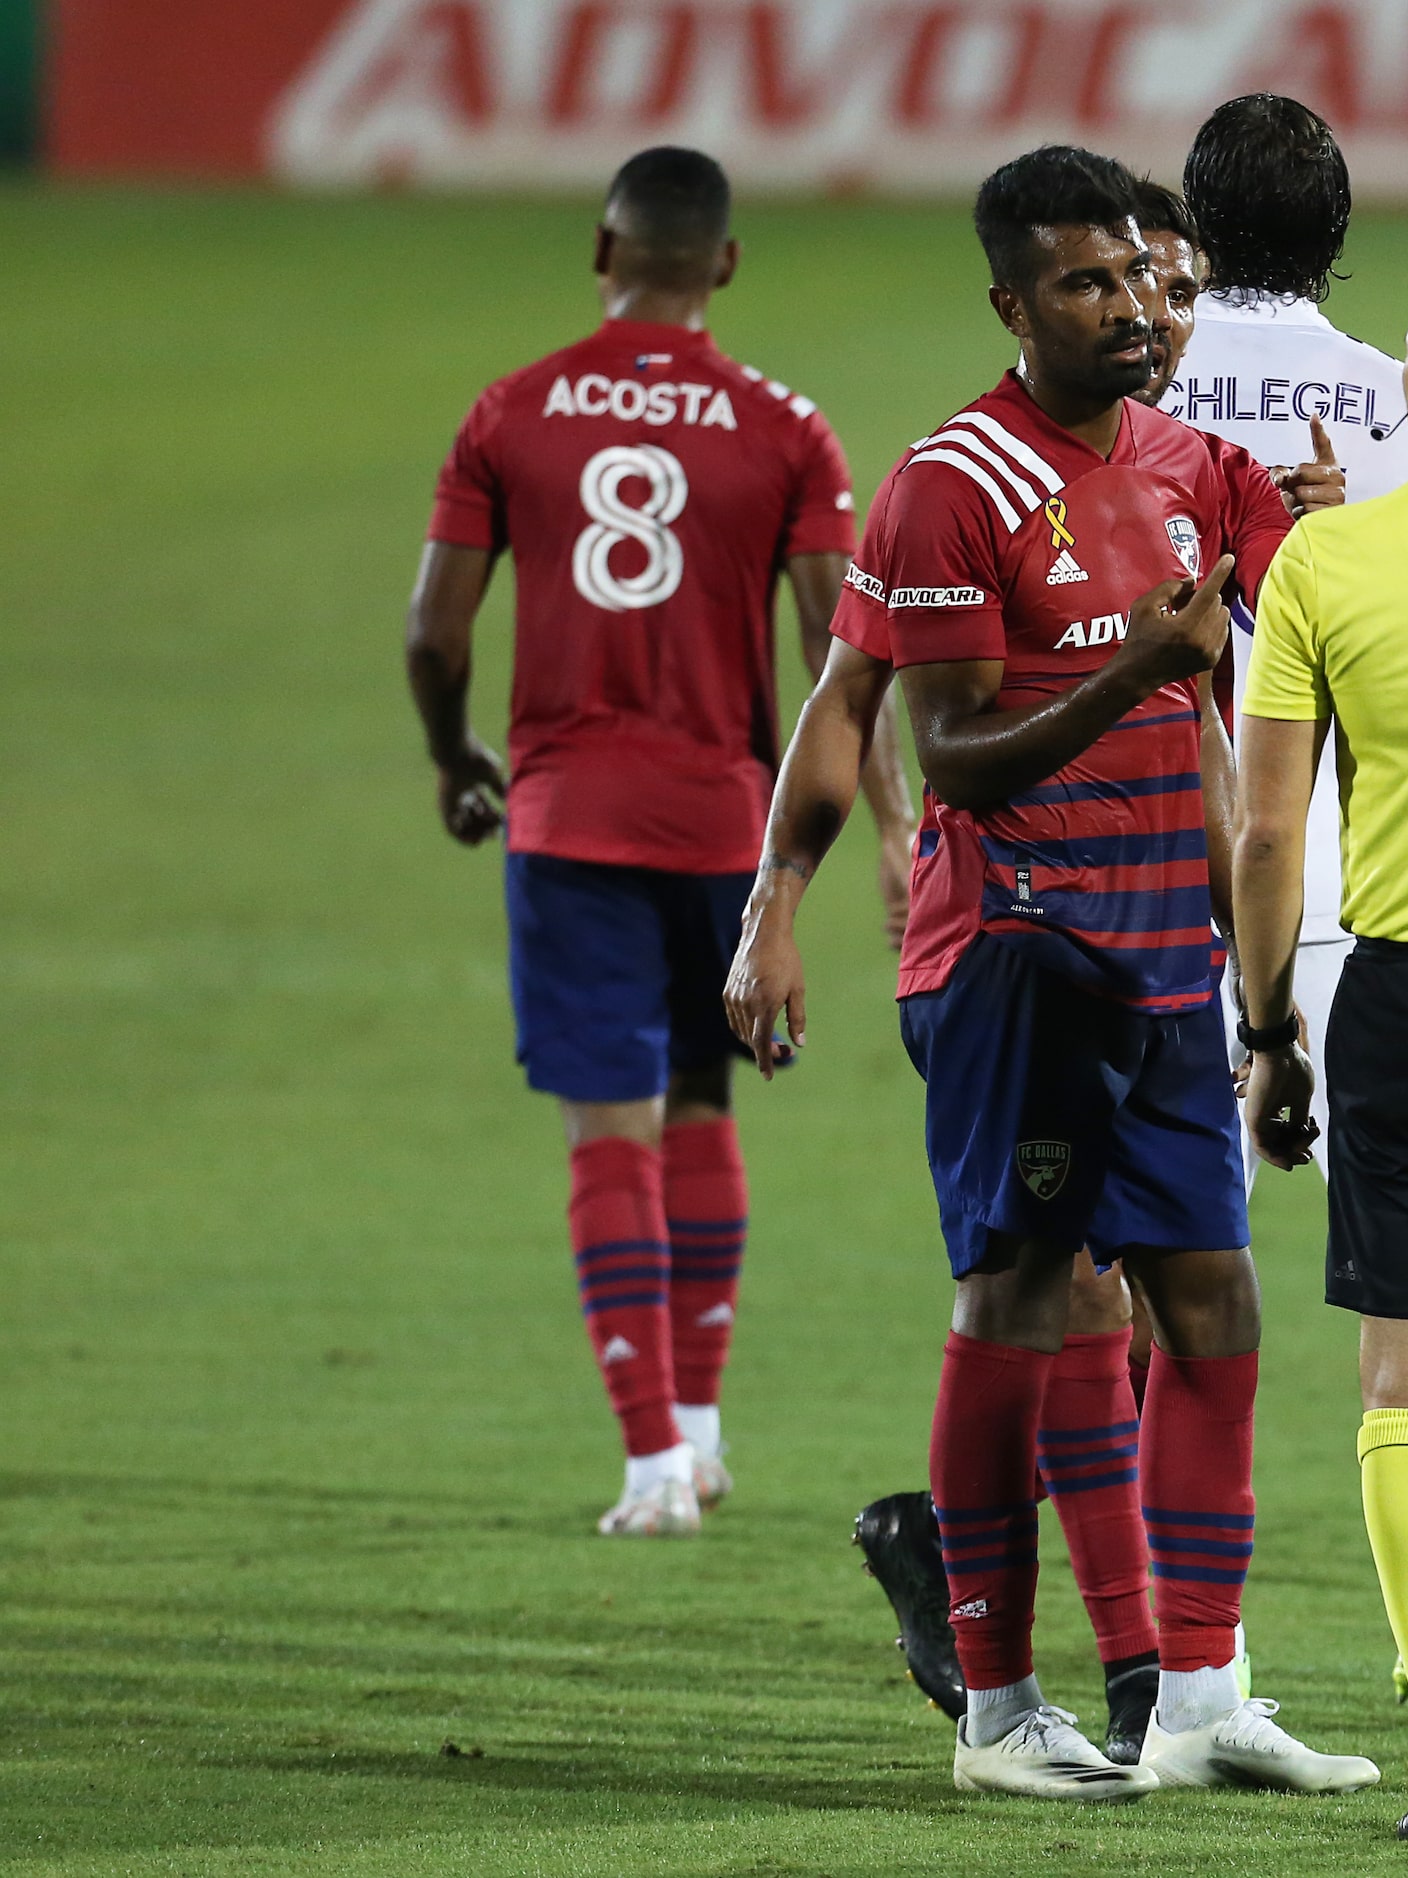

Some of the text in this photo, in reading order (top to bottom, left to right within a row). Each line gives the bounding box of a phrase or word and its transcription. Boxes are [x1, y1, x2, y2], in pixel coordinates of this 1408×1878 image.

[542, 373, 739, 432] ACOSTA
[572, 443, 689, 613] 8
[1046, 570, 1089, 585] adidas
[887, 586, 985, 609] ADVOCARE
[1021, 1144, 1067, 1160] FC DALLAS
